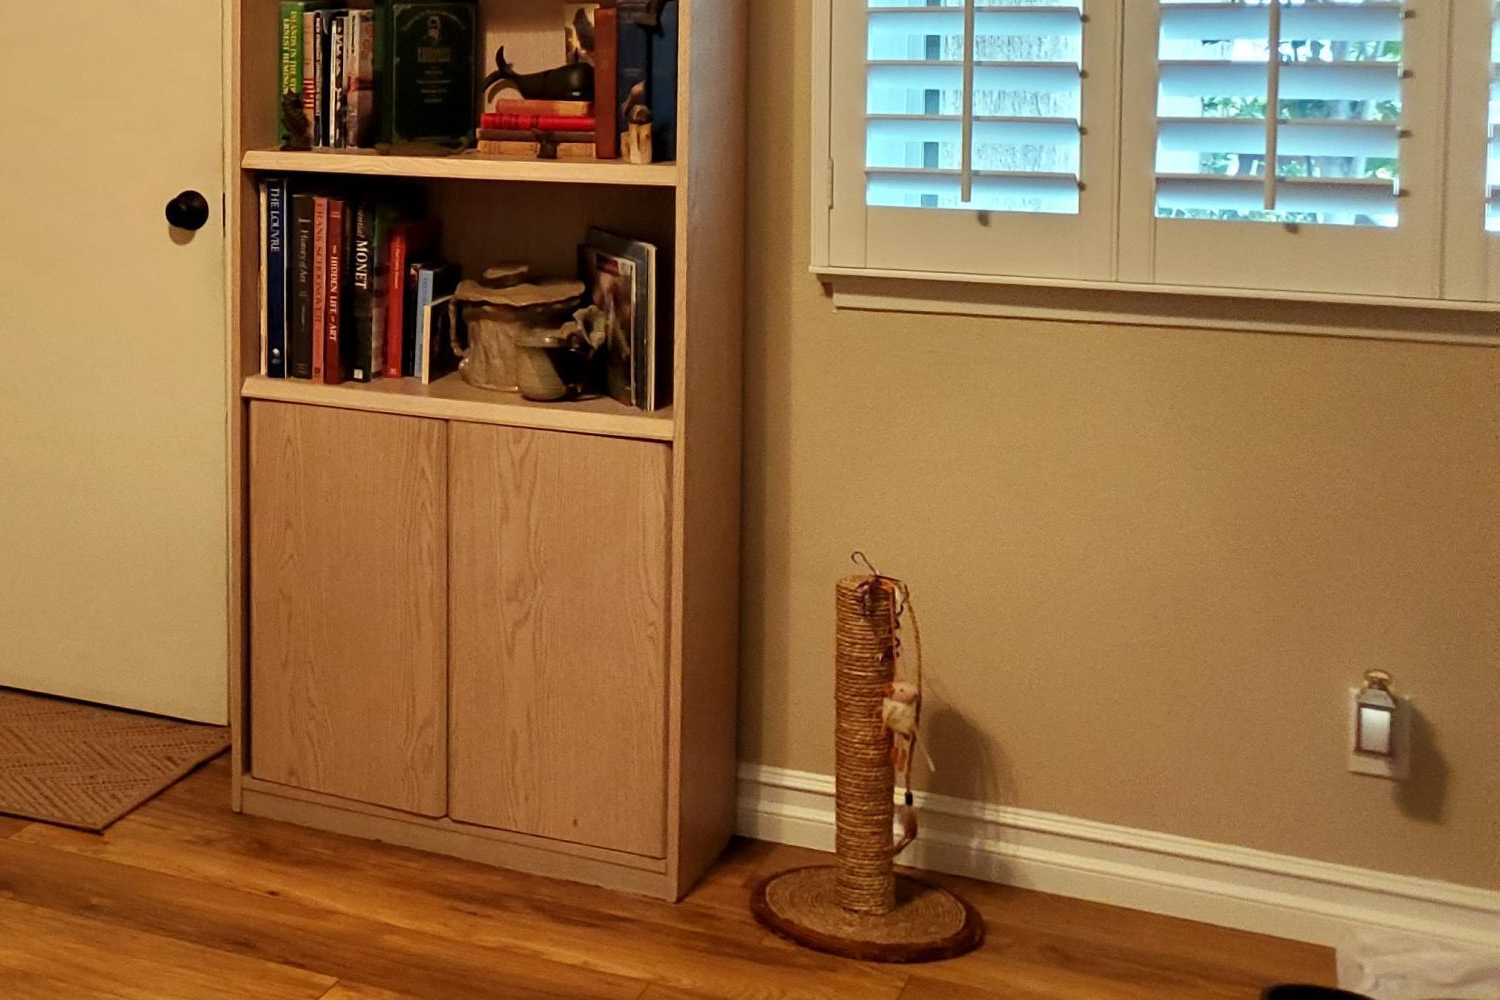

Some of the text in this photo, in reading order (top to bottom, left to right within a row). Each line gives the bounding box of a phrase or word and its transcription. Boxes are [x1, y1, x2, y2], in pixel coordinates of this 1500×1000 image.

[269, 187, 280, 253] THE LOUVRE
[330, 256, 339, 292] HIDDEN
[354, 240, 369, 290] MONET
[328, 323, 338, 342] ART
